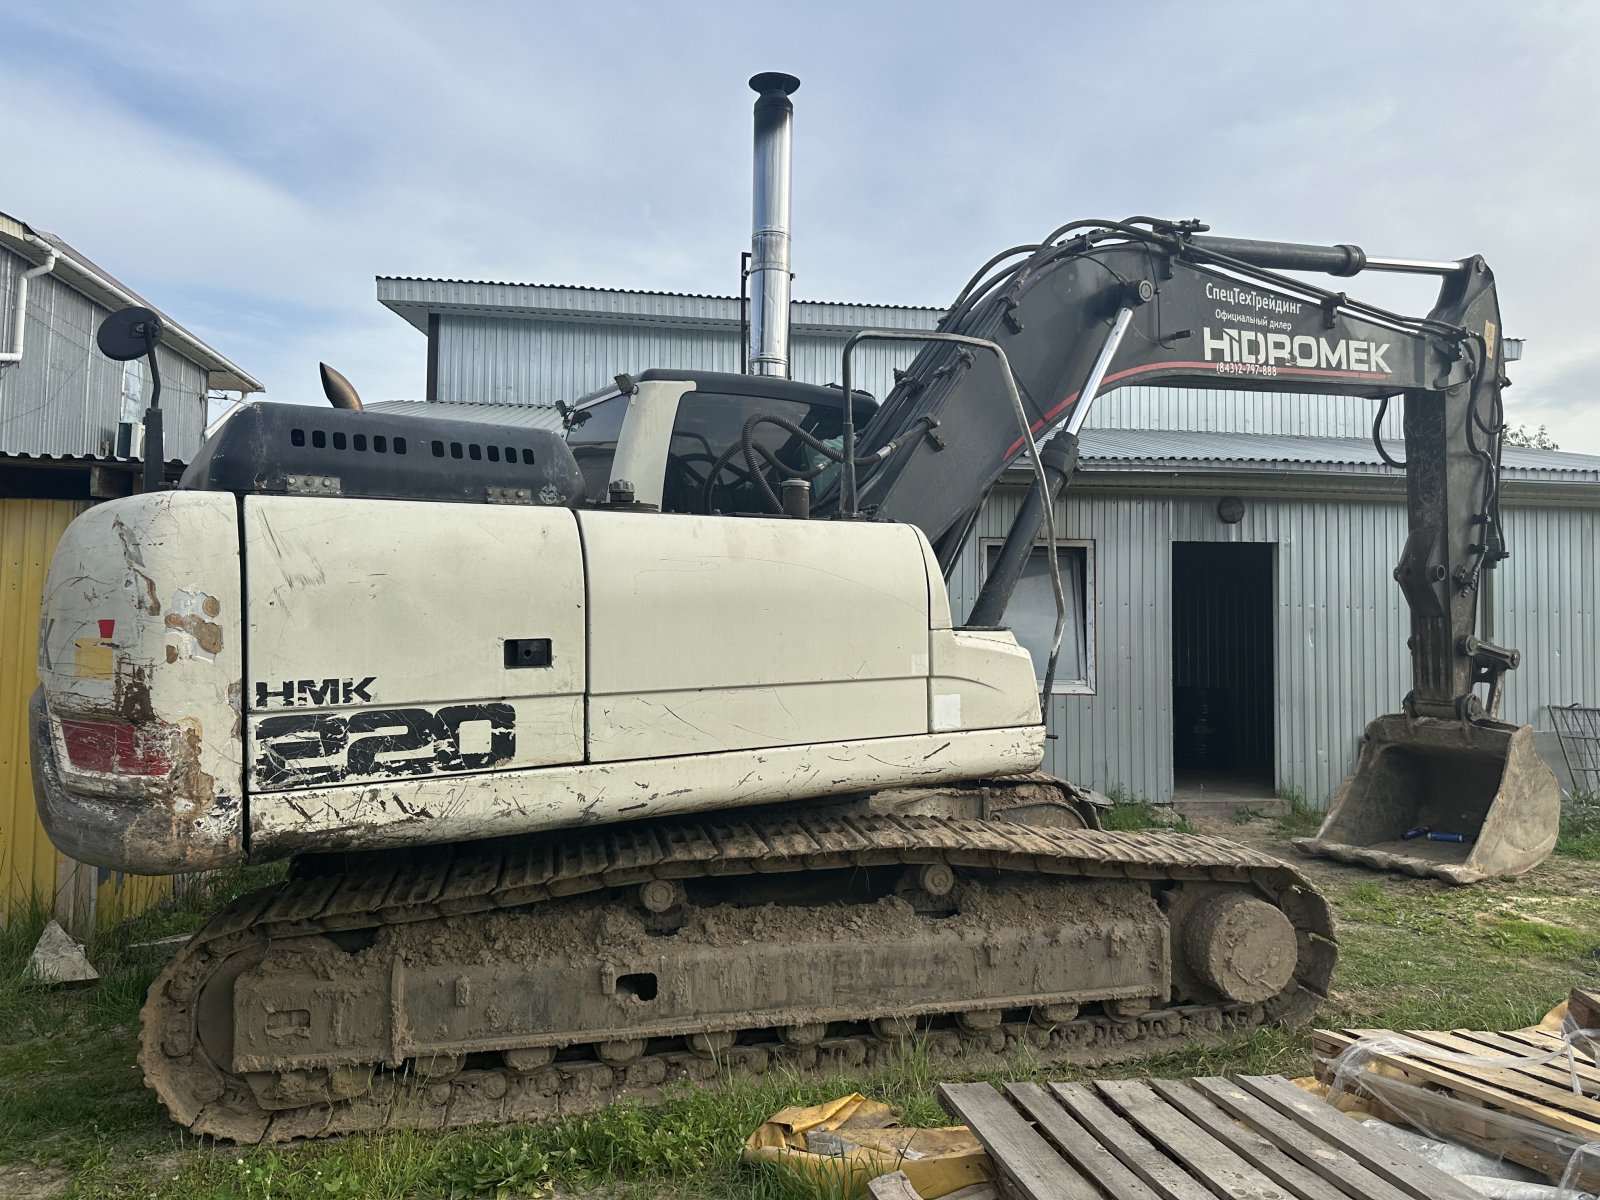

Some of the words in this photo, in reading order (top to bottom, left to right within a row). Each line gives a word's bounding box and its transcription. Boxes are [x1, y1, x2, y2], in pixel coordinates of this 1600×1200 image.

[1206, 282, 1302, 314] СпецТехТрейдинг
[1215, 308, 1268, 327] Официальный
[1269, 320, 1292, 332] дилер
[1216, 362, 1277, 376] (843)2-797-888
[255, 676, 378, 707] HMK
